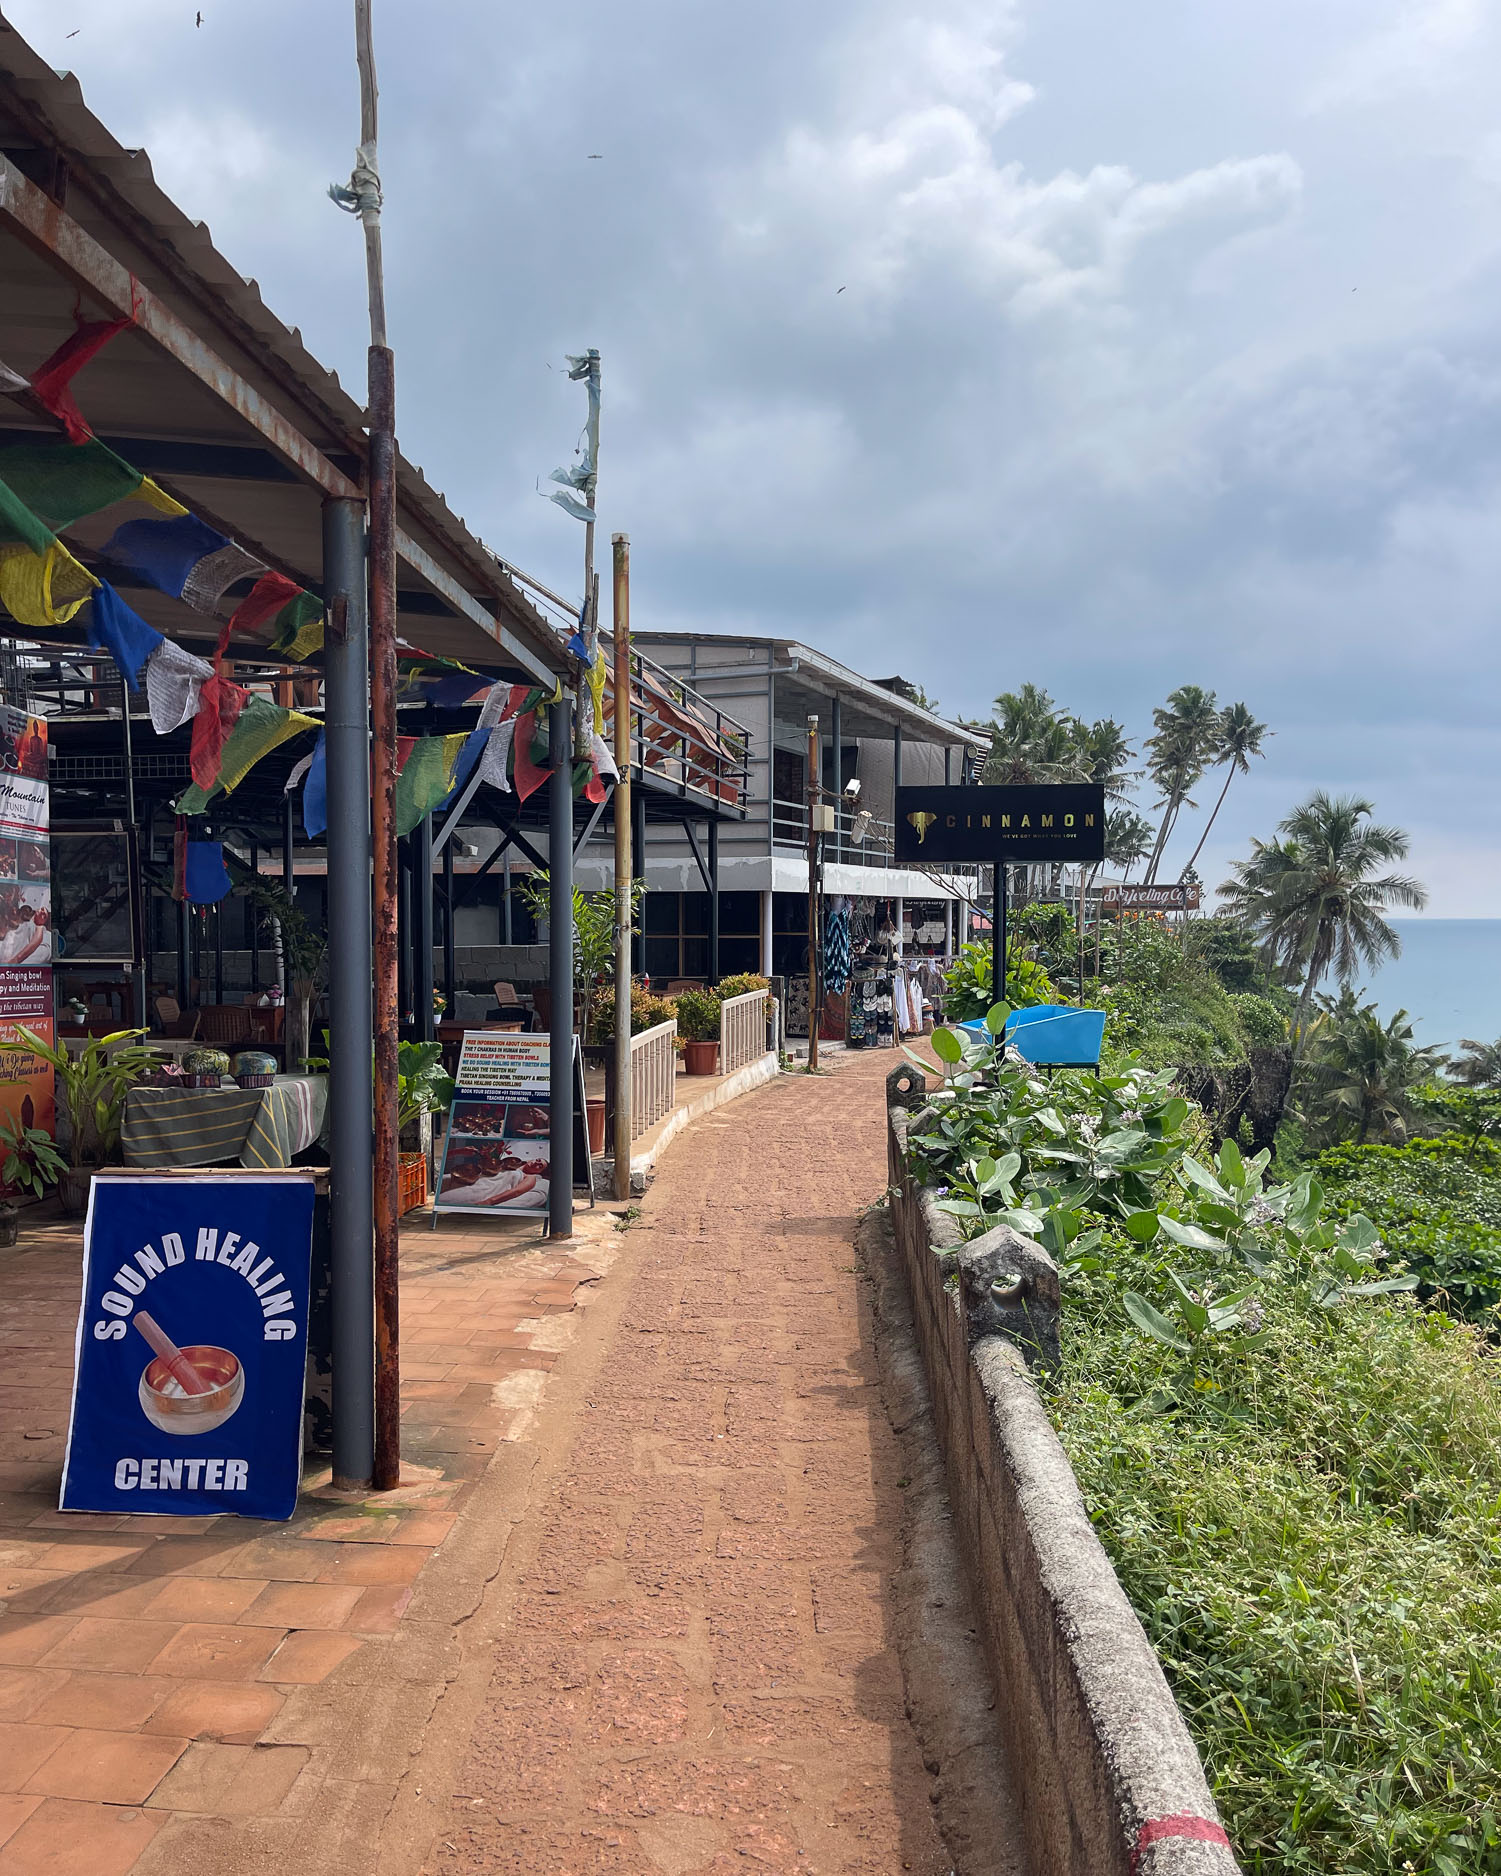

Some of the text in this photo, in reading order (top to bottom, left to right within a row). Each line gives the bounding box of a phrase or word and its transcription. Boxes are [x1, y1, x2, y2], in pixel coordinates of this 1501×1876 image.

[0, 784, 45, 804] Mountain
[6, 802, 26, 813] TUNES
[946, 814, 1094, 828] CINNAMON
[6, 971, 27, 981] Singing
[29, 971, 42, 979] bowl
[9, 983, 19, 992] and
[21, 983, 50, 991] Meditation
[94, 1227, 297, 1341] SOUND HEALING
[114, 1458, 249, 1491] CENTER
